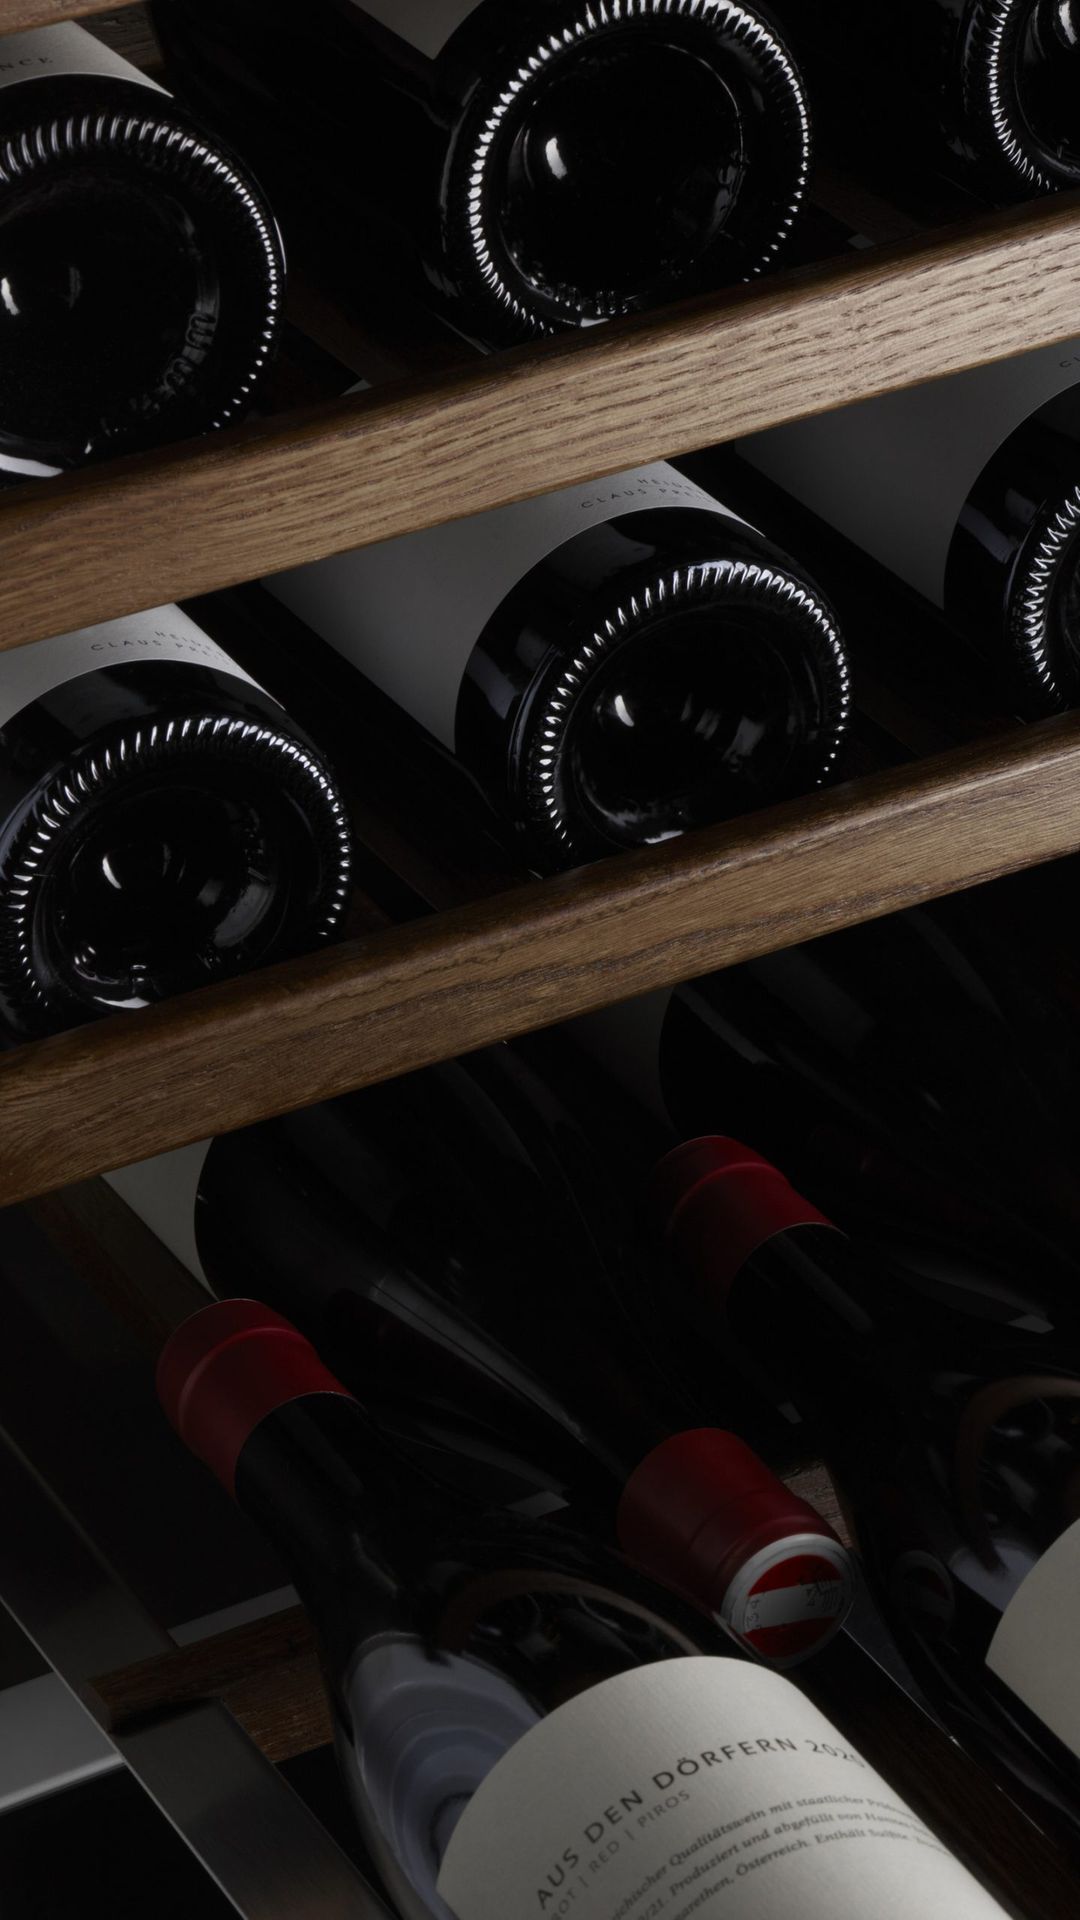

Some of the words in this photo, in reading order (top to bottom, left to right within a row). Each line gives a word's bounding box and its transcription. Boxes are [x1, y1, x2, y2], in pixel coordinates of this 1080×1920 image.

[581, 488, 647, 509] CLAUS
[90, 639, 162, 652] CLAUS
[537, 1848, 579, 1910] AUS
[584, 1790, 643, 1844] DEN
[652, 1738, 797, 1789] DÖRFERN
[588, 1840, 620, 1873] RED
[637, 1789, 691, 1828] PIROS
[669, 1808, 766, 1866] Qualitätswein
[769, 1800, 793, 1815] mit
[669, 1844, 740, 1896] Produziert
[741, 1828, 771, 1848] und
[774, 1813, 834, 1836] abgefüllt
[837, 1813, 862, 1821] von
[814, 1828, 866, 1844] Enthält
